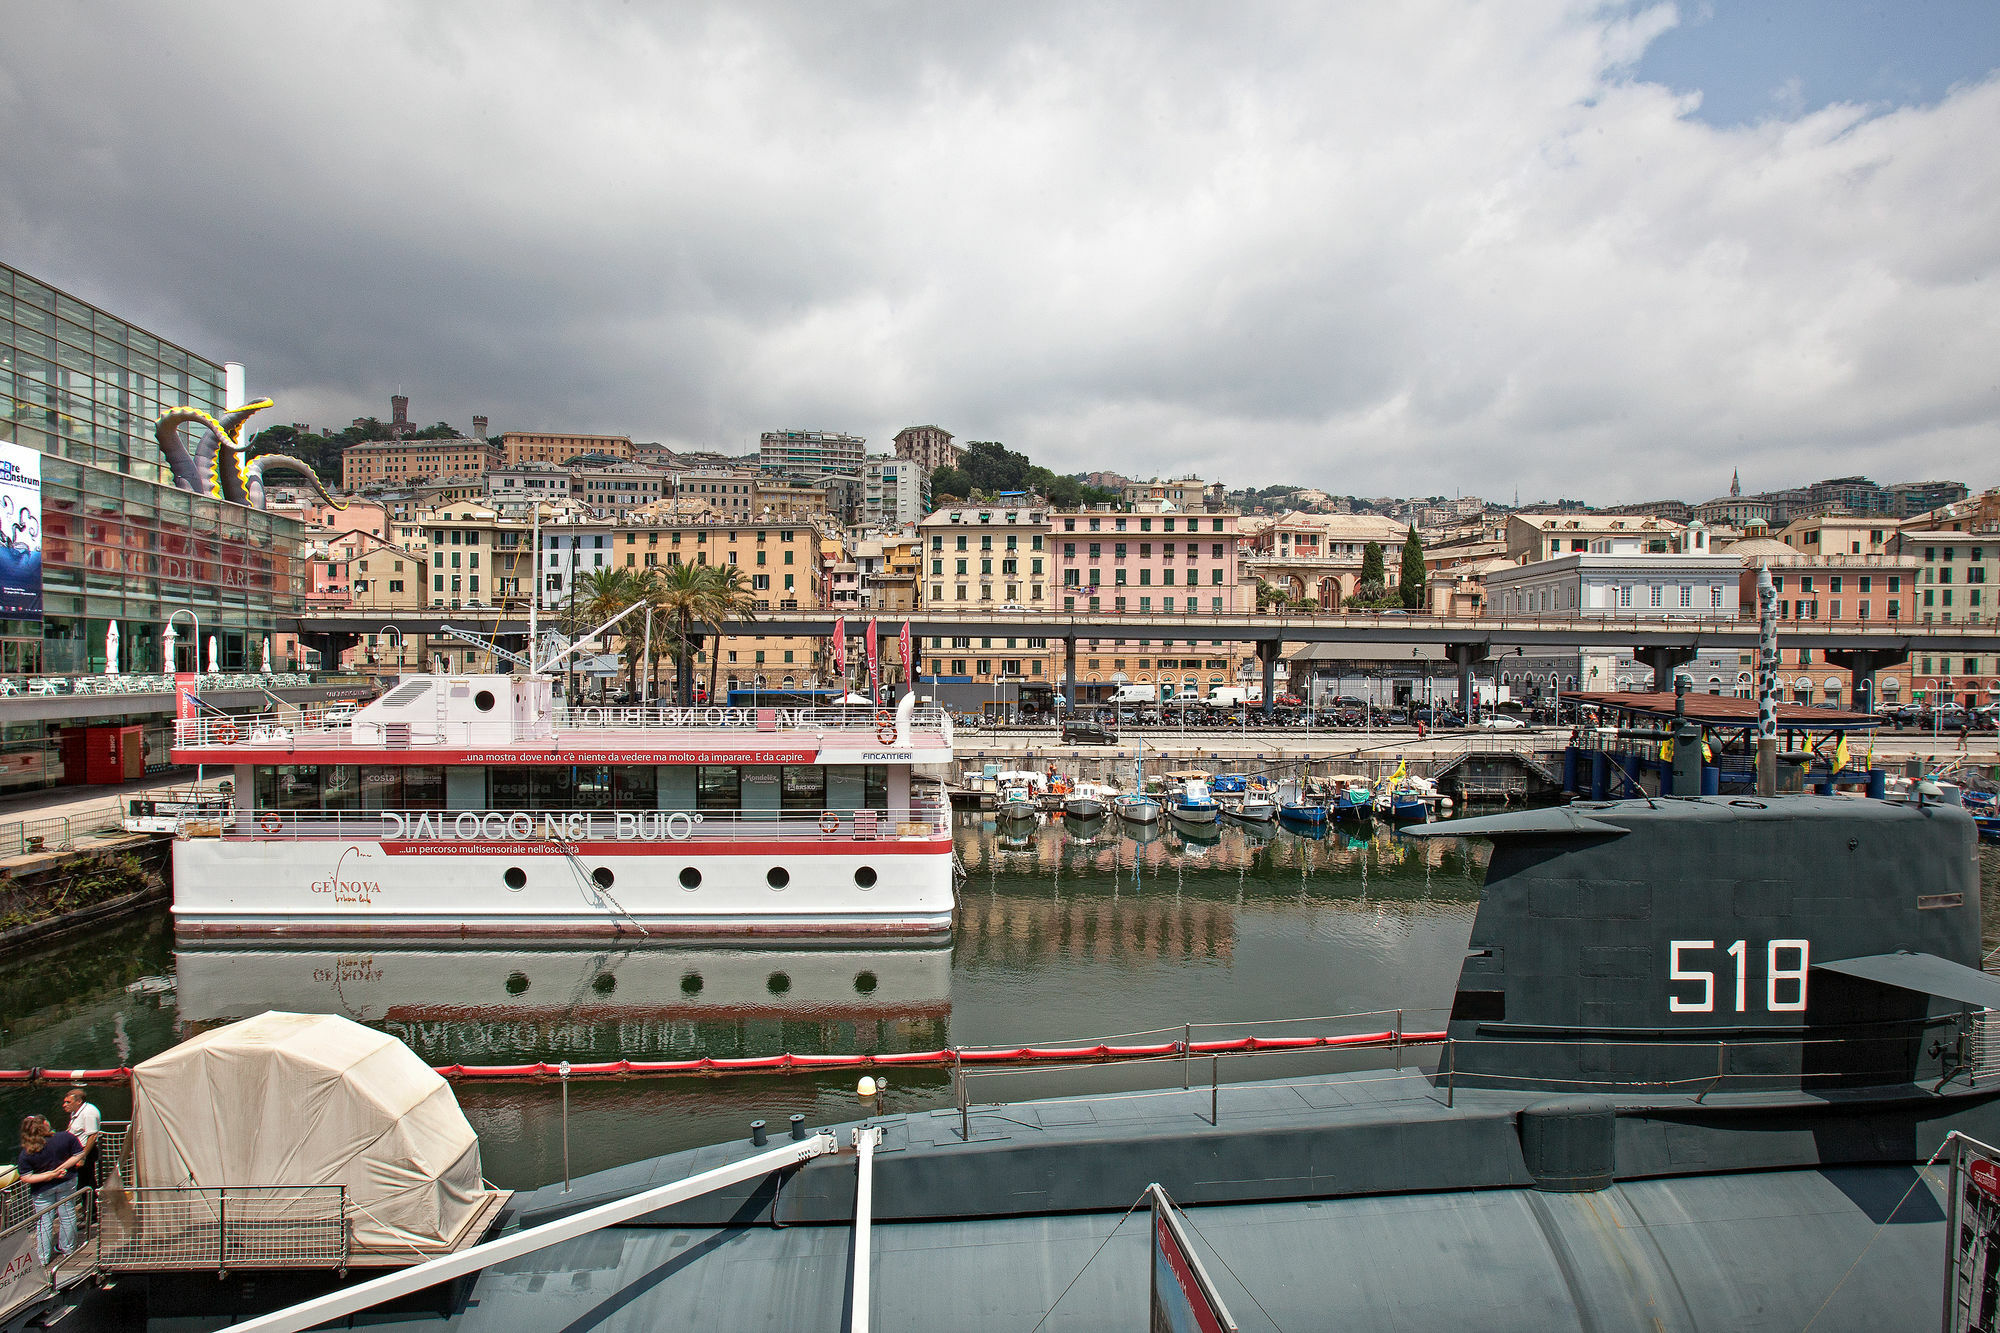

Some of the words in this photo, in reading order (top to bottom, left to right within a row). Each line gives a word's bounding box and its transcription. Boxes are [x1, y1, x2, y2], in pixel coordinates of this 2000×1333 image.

[461, 754, 484, 762] ...una
[486, 753, 516, 762] mostra
[520, 752, 541, 762] dove
[544, 754, 561, 762] non
[563, 752, 575, 762] c'è
[578, 752, 606, 762] niente
[608, 752, 619, 762] da
[621, 752, 651, 762] vedere
[653, 754, 666, 762] ma
[669, 752, 696, 762] molto
[698, 752, 710, 762] da
[711, 752, 753, 764] imparare.
[755, 752, 761, 762] E
[763, 752, 774, 762] da
[776, 752, 805, 764] capire.
[381, 812, 533, 840] DIALOGO
[544, 812, 605, 840] NEL
[400, 845, 417, 854] ...un
[419, 845, 457, 856] percorso
[460, 843, 525, 854] multisensoriale
[311, 881, 381, 893] GENOVA
[1669, 939, 1810, 1013] 518
[0, 1252, 32, 1280] ATA
